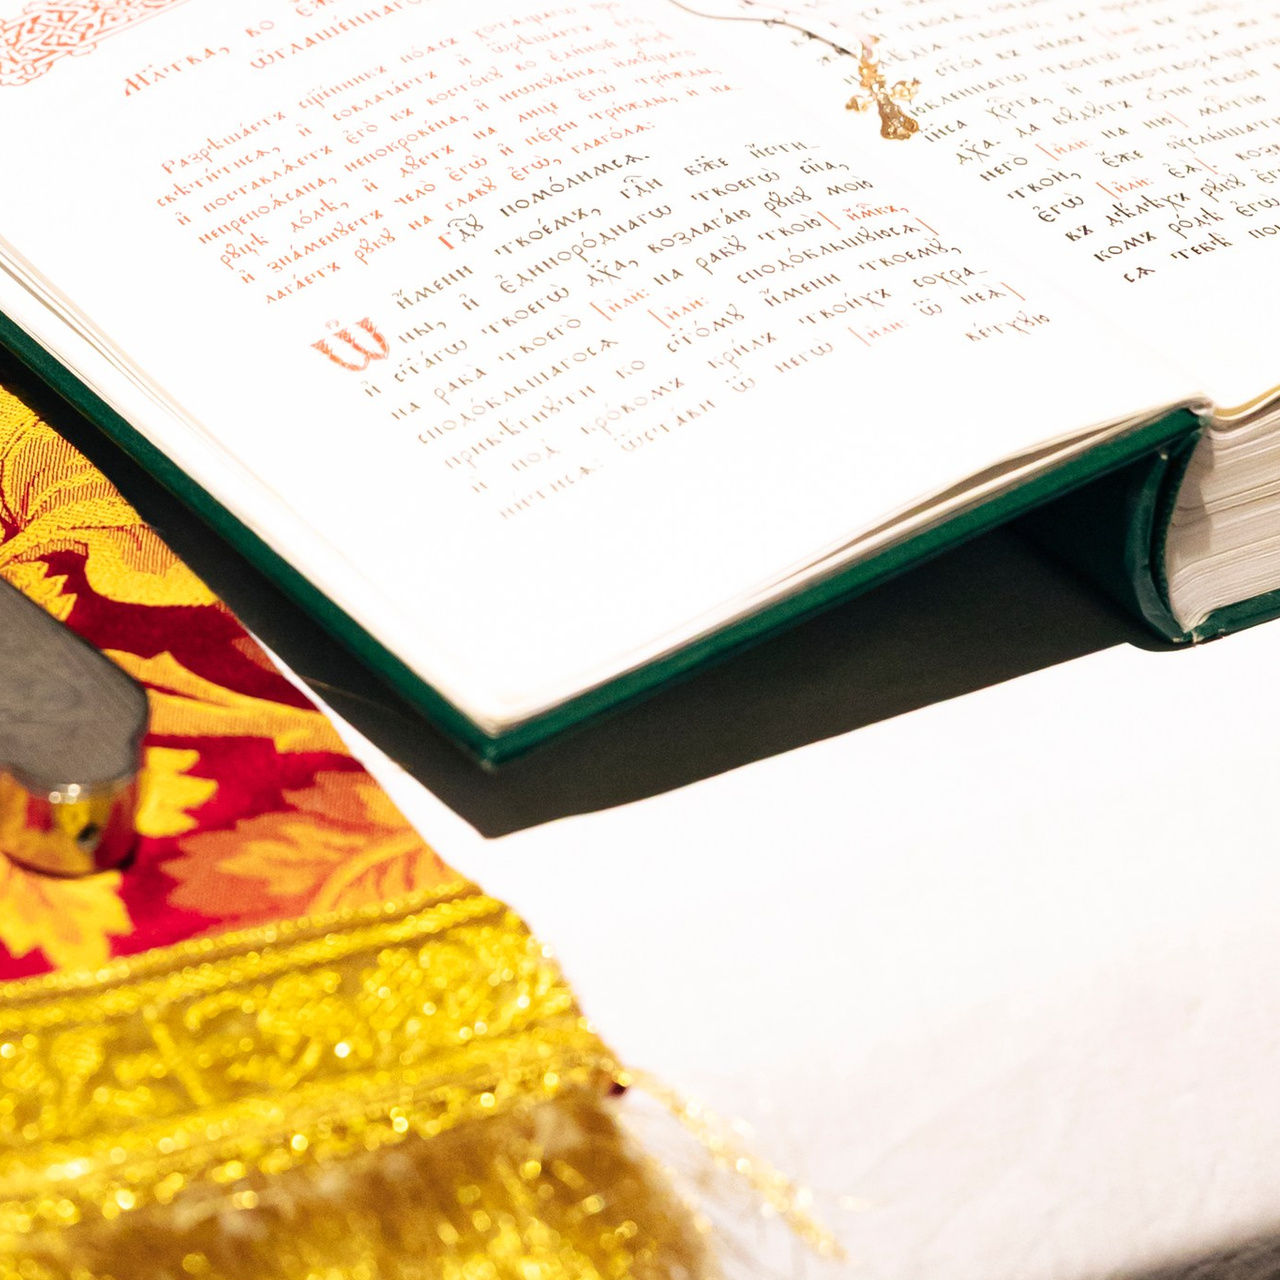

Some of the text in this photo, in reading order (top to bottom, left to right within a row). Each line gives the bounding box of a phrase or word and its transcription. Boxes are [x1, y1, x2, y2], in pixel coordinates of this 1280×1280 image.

[472, 126, 498, 140] на
[1014, 123, 1041, 139] да
[1100, 127, 1130, 139] на
[408, 214, 434, 230] на
[1064, 225, 1094, 242] въ
[391, 402, 421, 420] на
[653, 269, 684, 285] на
[615, 360, 645, 379] ко
